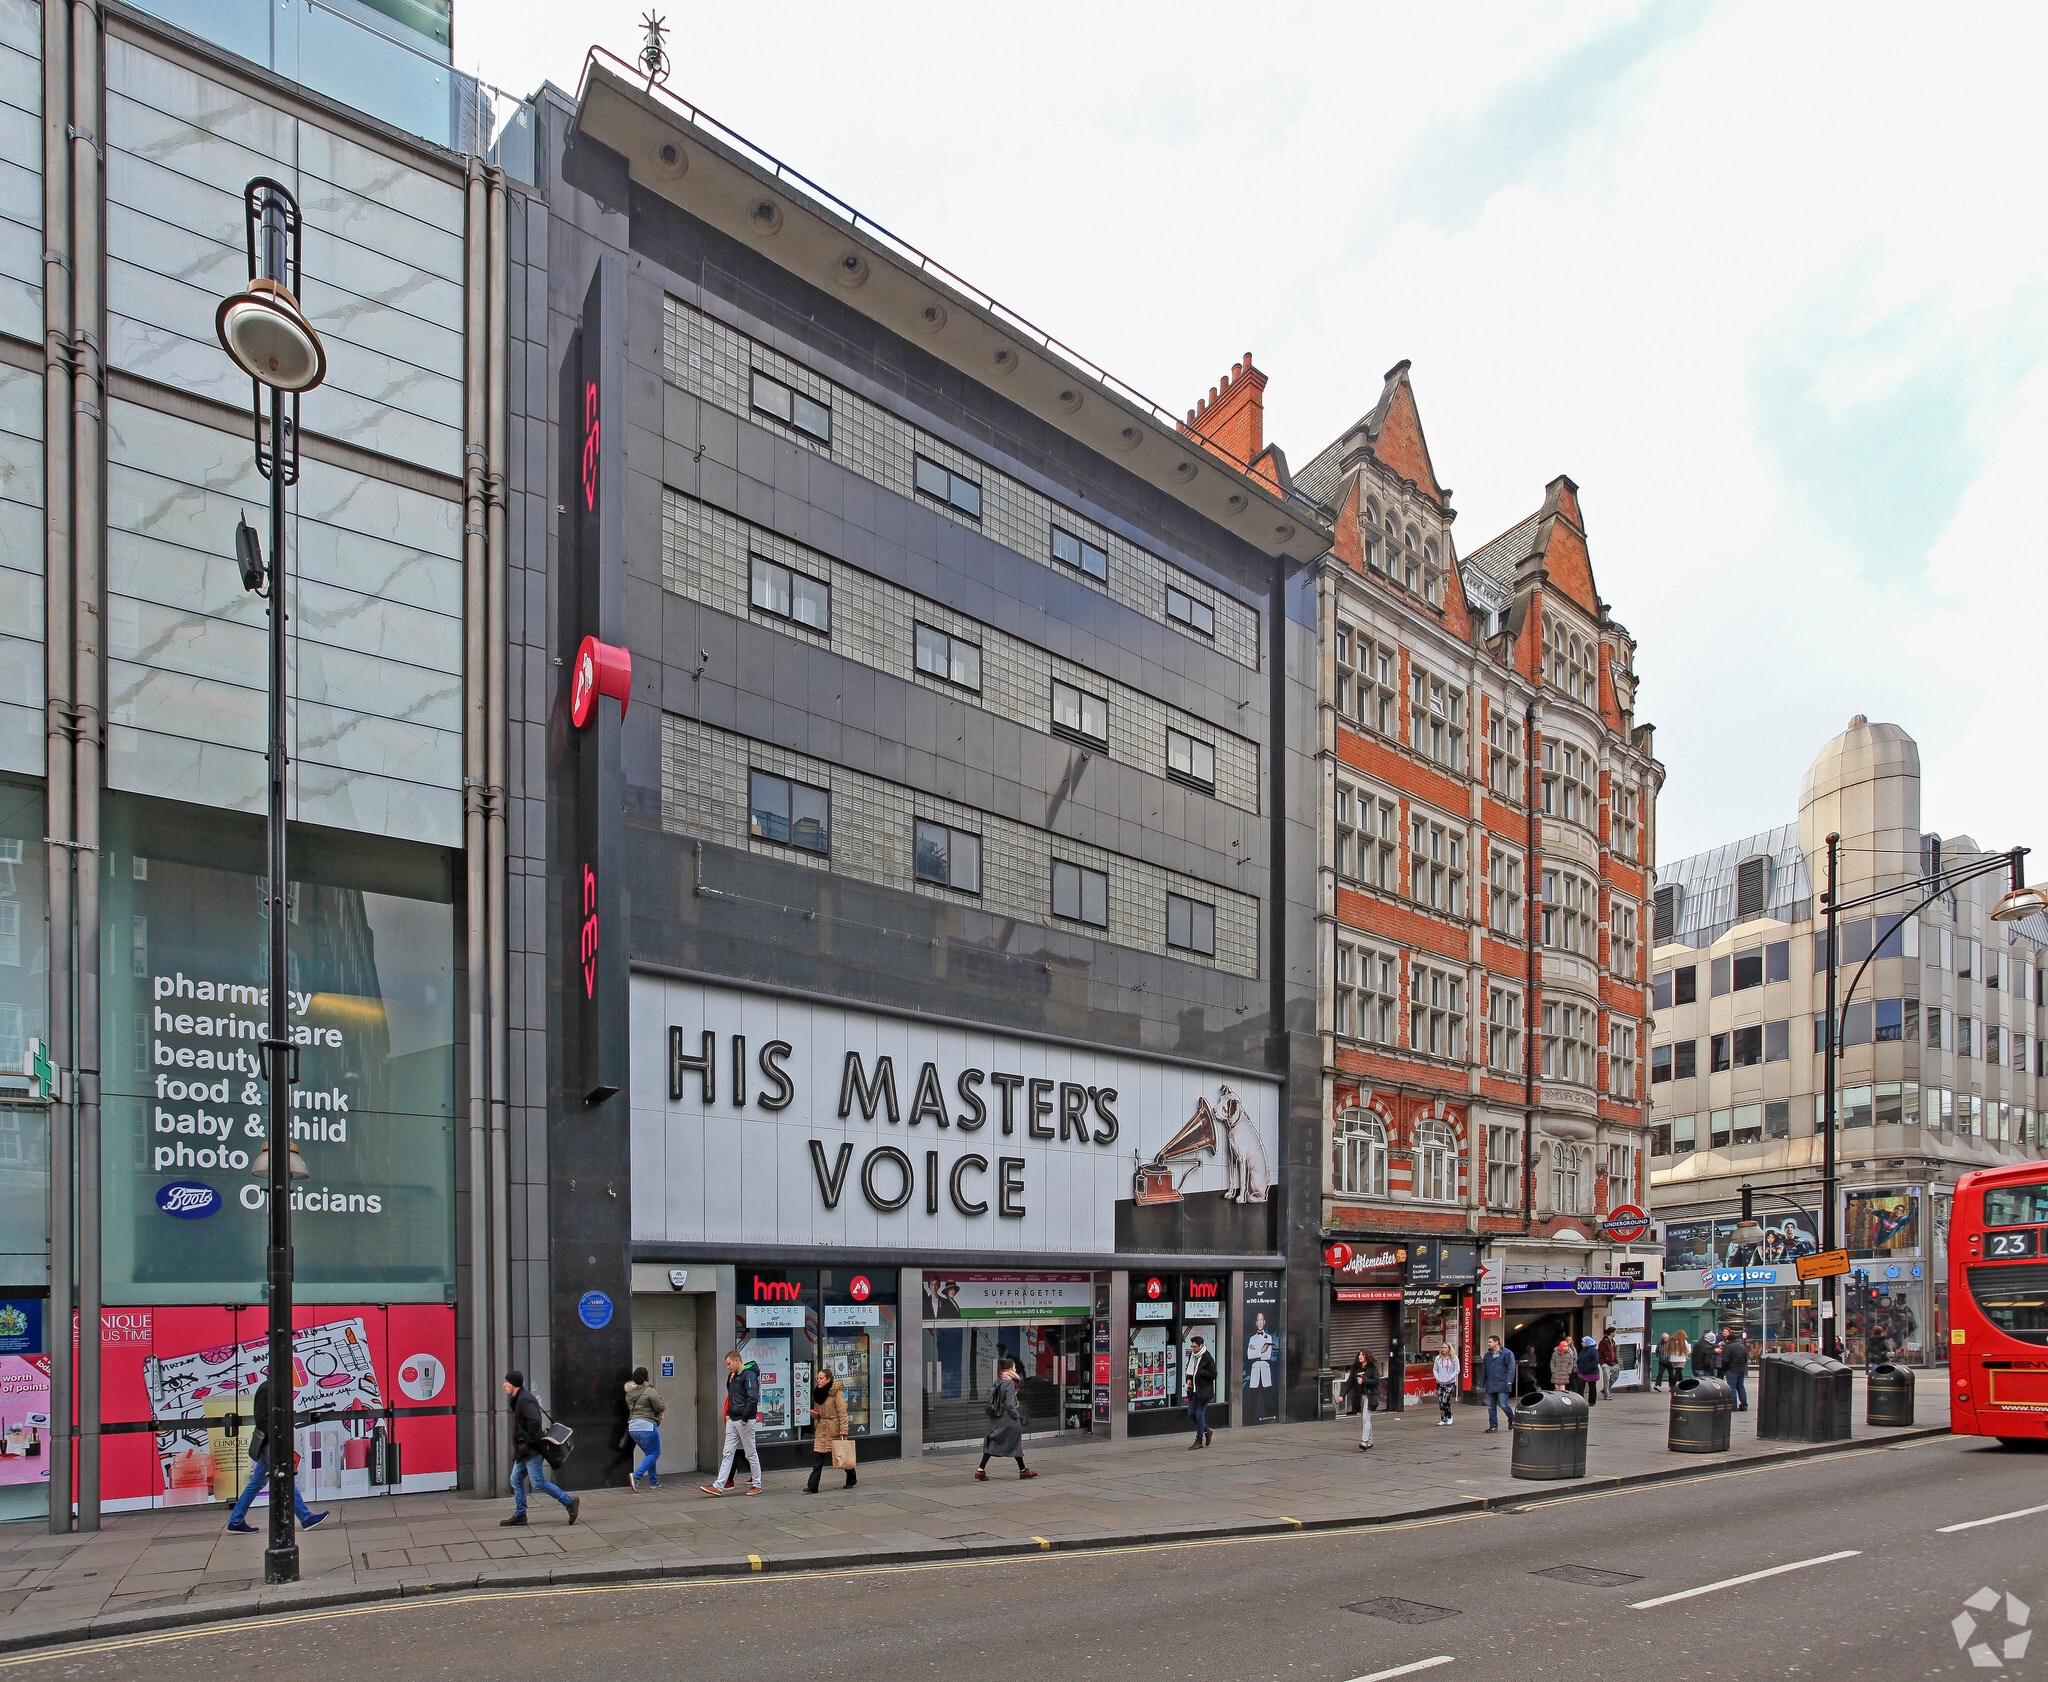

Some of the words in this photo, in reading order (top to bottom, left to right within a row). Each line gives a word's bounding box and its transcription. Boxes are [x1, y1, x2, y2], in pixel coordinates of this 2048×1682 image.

[584, 380, 600, 512] hmv
[581, 863, 598, 999] hmv
[154, 1040, 261, 1078] beauty
[155, 1074, 230, 1104] food
[240, 1081, 263, 1106] &
[288, 1083, 349, 1112] rink
[668, 1025, 795, 1111] HIS
[837, 1050, 1119, 1145] MASTER'S
[155, 1107, 234, 1141] baby
[243, 1113, 266, 1138] &
[154, 1141, 249, 1171] photo
[809, 1139, 1026, 1218] VOICE
[162, 1186, 213, 1212] Boots
[1603, 1219, 1648, 1228] UNDERGROUND
[1993, 1235, 2026, 1255] 23
[753, 1275, 801, 1301] hmv
[984, 1289, 1063, 1297] SUFFRAGETTE
[1189, 1278, 1218, 1298] hmv
[1244, 1280, 1278, 1288] SPECTRE
[1424, 1289, 1440, 1297] Change
[1577, 1282, 1592, 1290] BOND
[1593, 1281, 1610, 1290] STREET
[1610, 1281, 1630, 1290] STATION
[1415, 1297, 1436, 1305] Exchange
[122, 1329, 152, 1341] TIME
[1463, 1307, 1471, 1342] exchange
[1463, 1343, 1471, 1379] Currency
[2, 1374, 33, 1383] worth
[2, 1384, 13, 1393] of
[16, 1384, 49, 1393] points
[213, 1439, 250, 1448] CLINIQUE
